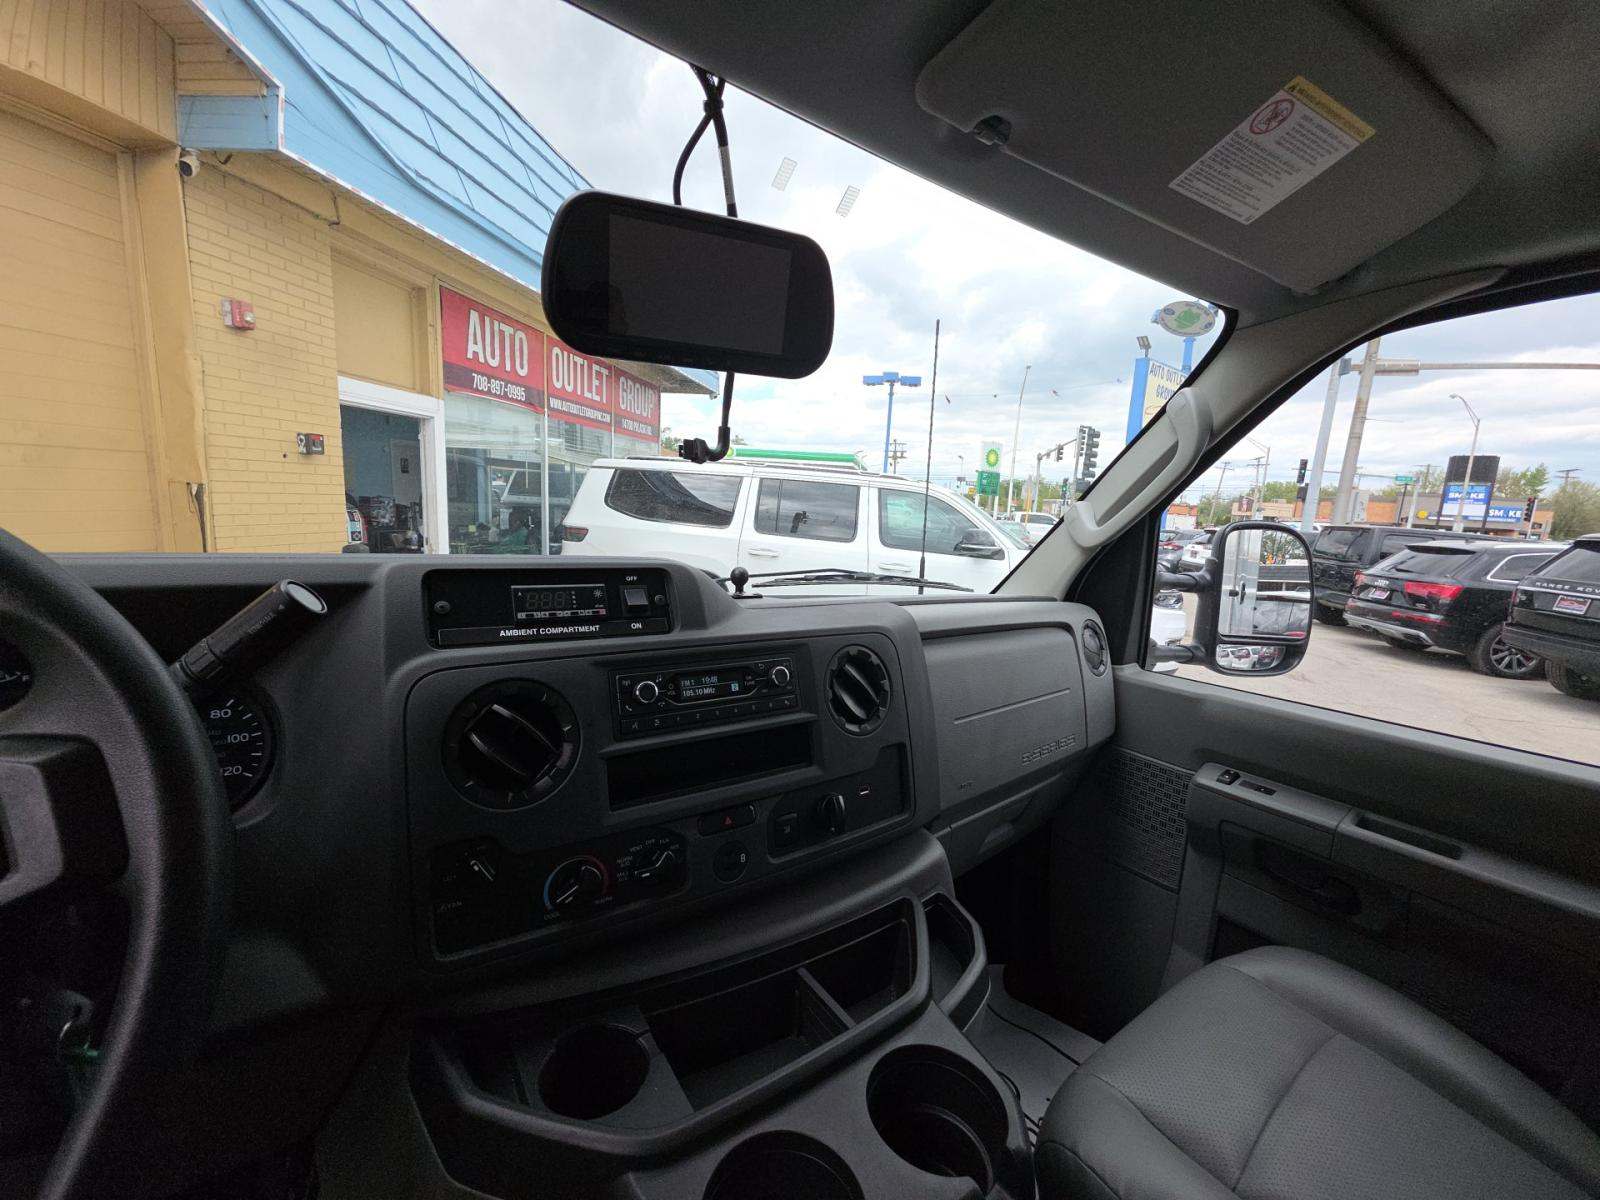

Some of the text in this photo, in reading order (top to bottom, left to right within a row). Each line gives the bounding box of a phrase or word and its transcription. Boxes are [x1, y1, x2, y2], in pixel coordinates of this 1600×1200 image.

[466, 308, 655, 418] AUTO OUTLET GROUP
[472, 373, 526, 401] 708-897-0995
[1488, 509, 1522, 518] SMKE
[499, 625, 600, 637] AMBIENT COMPARTMENT
[210, 708, 232, 719] 80
[227, 733, 250, 744] 100
